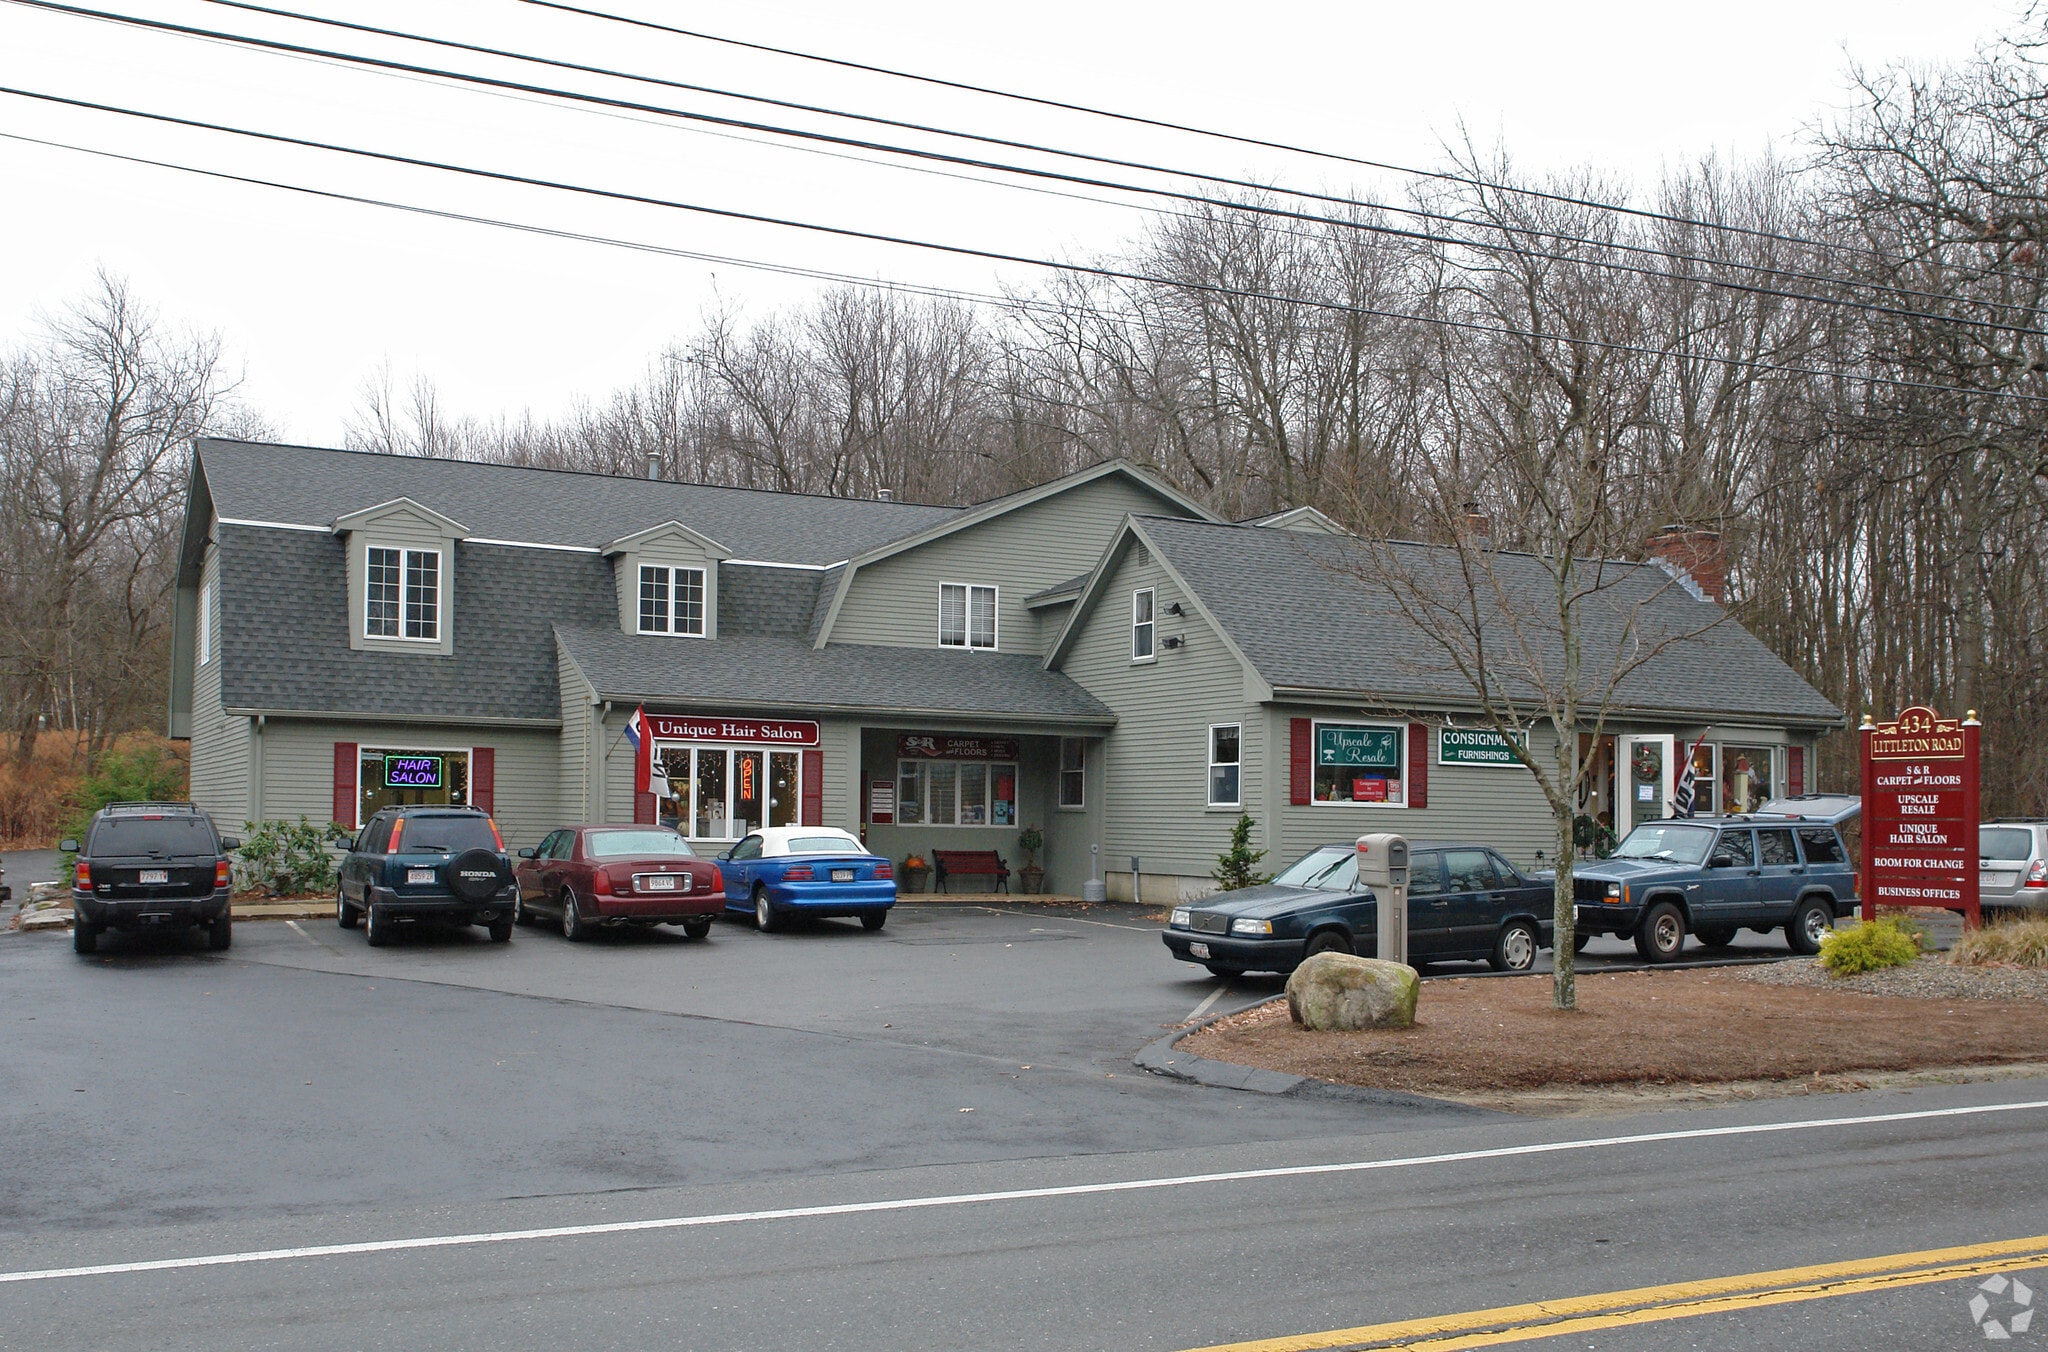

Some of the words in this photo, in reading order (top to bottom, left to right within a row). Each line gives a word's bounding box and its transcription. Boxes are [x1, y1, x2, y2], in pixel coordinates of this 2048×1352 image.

[658, 721, 717, 738] Unique
[721, 723, 757, 737] Hair
[761, 725, 803, 739] Salon
[1900, 716, 1931, 734] 434
[947, 740, 980, 748] CARPET
[1326, 731, 1374, 751] Upscale
[1873, 739, 1930, 753] LITTLETON
[1931, 737, 1962, 751] ROAD
[954, 749, 988, 757] FLOORS
[1345, 746, 1387, 763] Resale
[1458, 749, 1510, 761] FURNISHINGS
[397, 759, 432, 771] HAIR
[1906, 765, 1912, 775] S
[1913, 765, 1921, 775] &
[1923, 765, 1930, 774] R
[390, 770, 437, 784] SALON
[742, 757, 752, 801] OPEN
[1877, 776, 1913, 785] CARPET
[1923, 775, 1961, 785] FLOORS
[1897, 794, 1940, 804] UPSCALE
[1901, 805, 1936, 814] RESALE
[1899, 824, 1938, 834] UNIQUE
[1889, 834, 1914, 843] HAIR
[1915, 834, 1948, 844] SALON
[1874, 857, 1902, 867] ROOM
[1903, 858, 1922, 868] FOR
[1923, 859, 1965, 869] CHANGE
[459, 870, 497, 878] HONDA
[1878, 886, 1921, 897] BUSINESS
[1922, 888, 1961, 899] OFFICES
